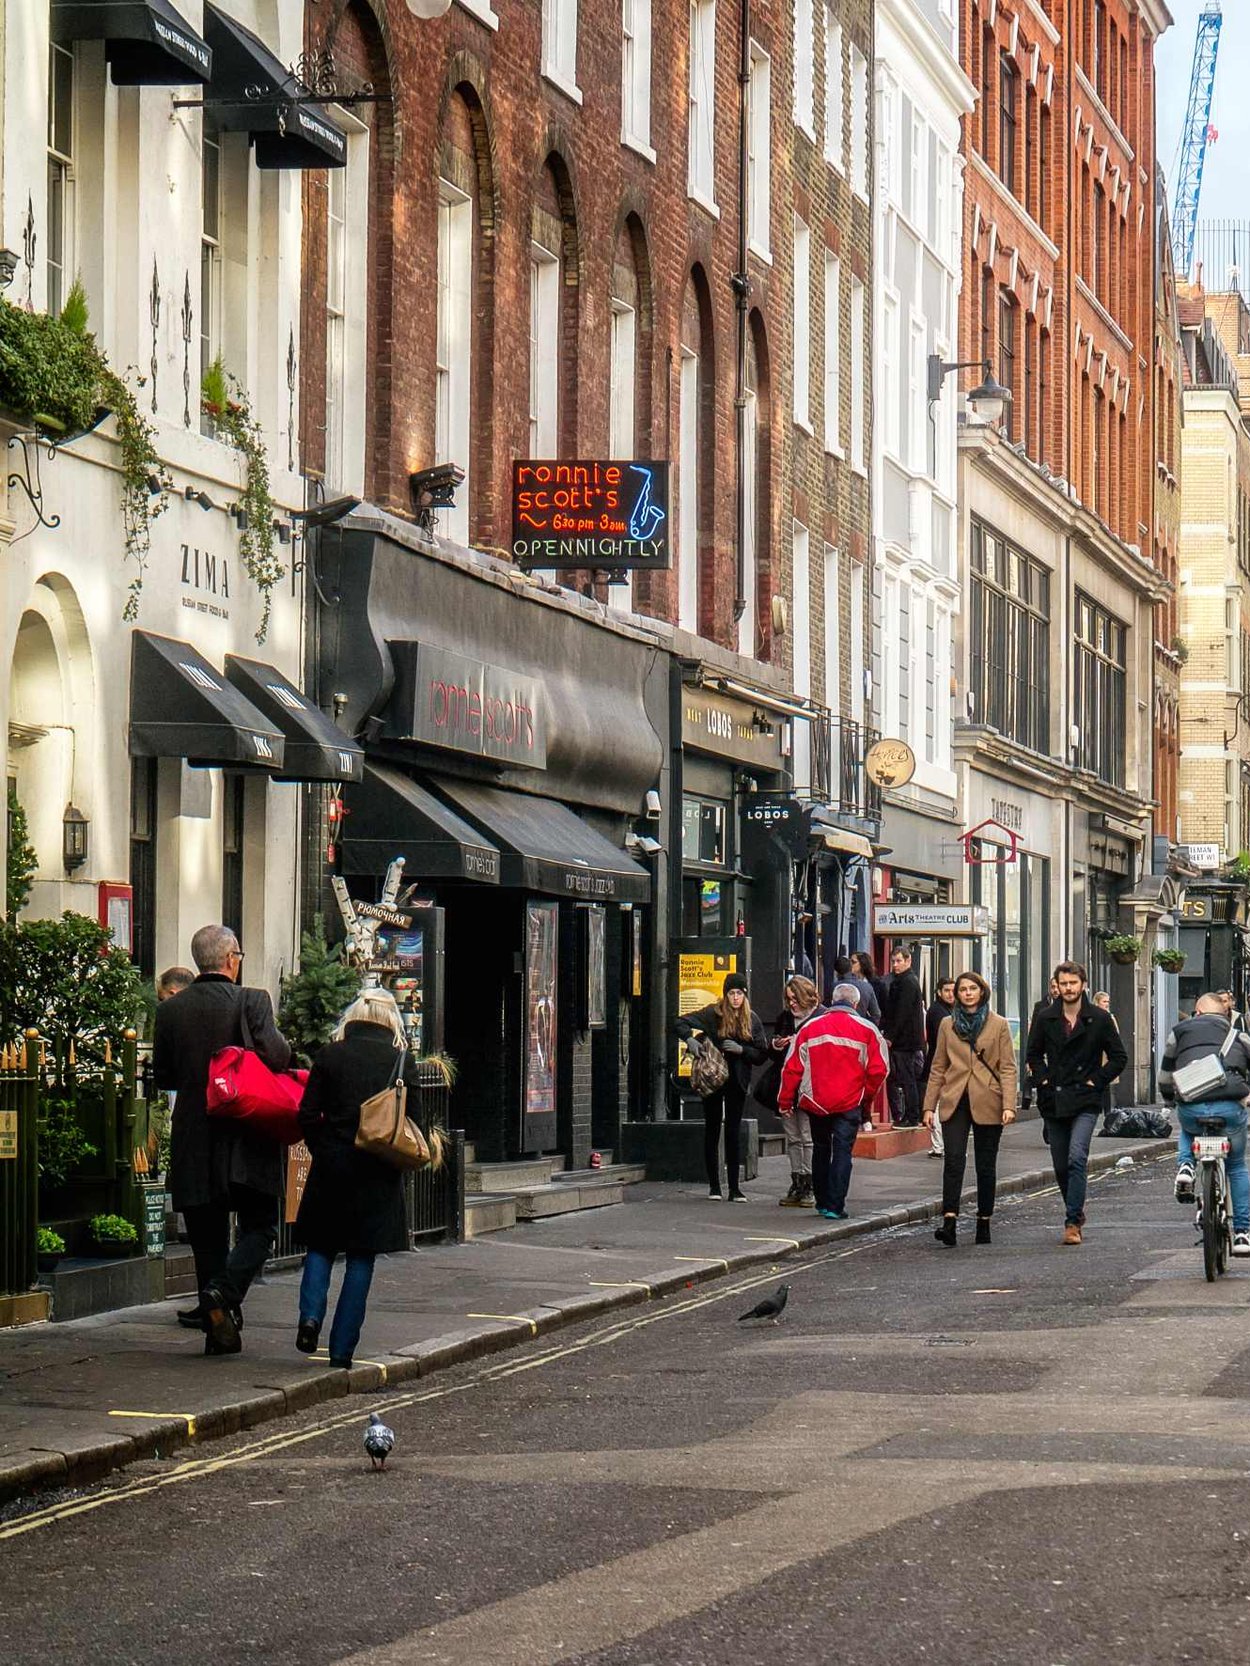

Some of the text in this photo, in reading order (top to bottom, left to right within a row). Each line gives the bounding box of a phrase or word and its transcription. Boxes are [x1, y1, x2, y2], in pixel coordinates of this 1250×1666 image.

[518, 463, 621, 484] ronnie
[518, 487, 619, 508] scott's
[180, 543, 230, 598] ZIMA
[178, 662, 223, 692] ZIMA
[266, 684, 307, 711] ZIMA
[428, 677, 481, 736] ronnie
[707, 706, 732, 740] LOBOS
[747, 810, 789, 819] LOBOS
[1190, 846, 1212, 854] TEMAN
[357, 902, 406, 926] РЮМОЧНАЯ
[888, 911, 915, 924] Arts
[946, 914, 969, 924] CLUB
